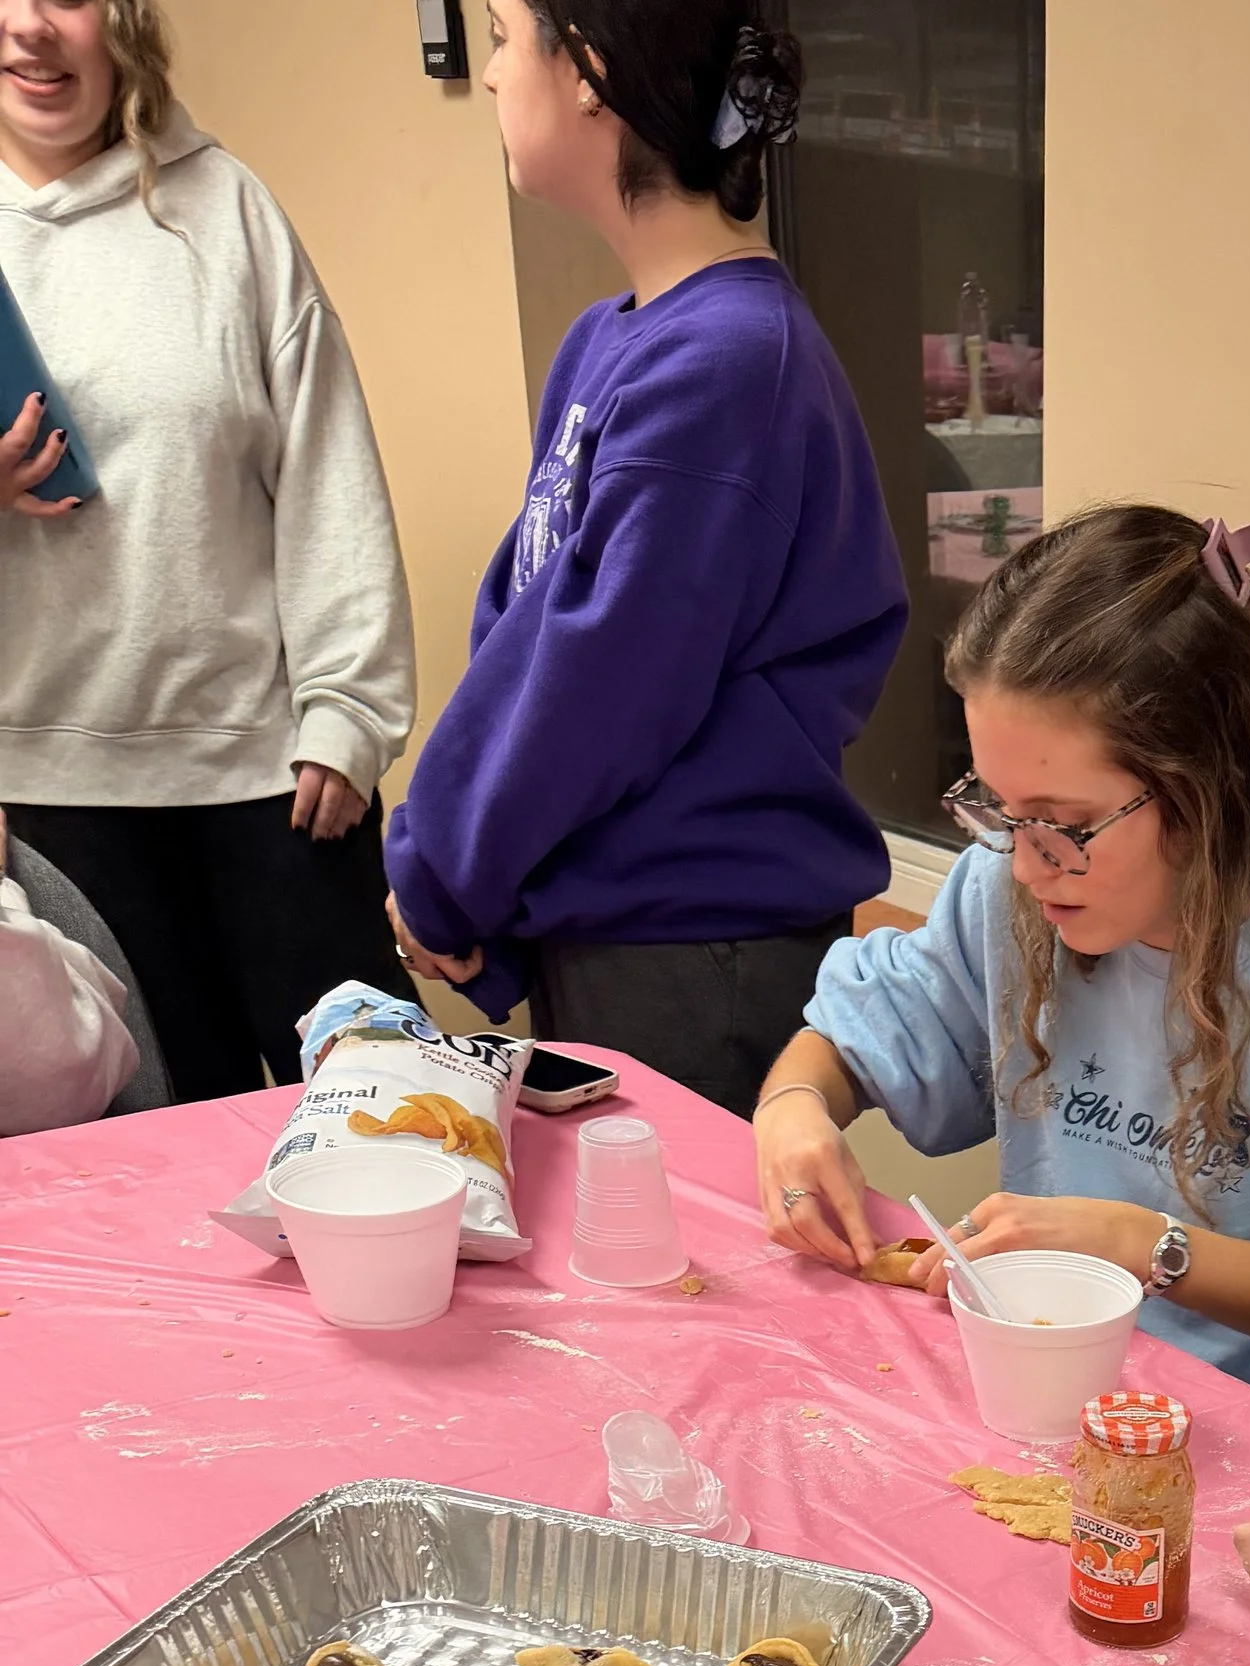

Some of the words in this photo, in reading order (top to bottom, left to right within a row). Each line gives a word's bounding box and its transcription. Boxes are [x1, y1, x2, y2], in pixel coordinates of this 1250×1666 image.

[417, 1043, 460, 1064] Kettle
[420, 1052, 465, 1075] Potato
[307, 1103, 351, 1116] Salt
[1064, 1084, 1123, 1133] Chi
[1062, 1128, 1091, 1142] MAKE
[1095, 1136, 1102, 1144] A
[1106, 1139, 1128, 1154] WISH
[1077, 1579, 1114, 1602] Apricot
